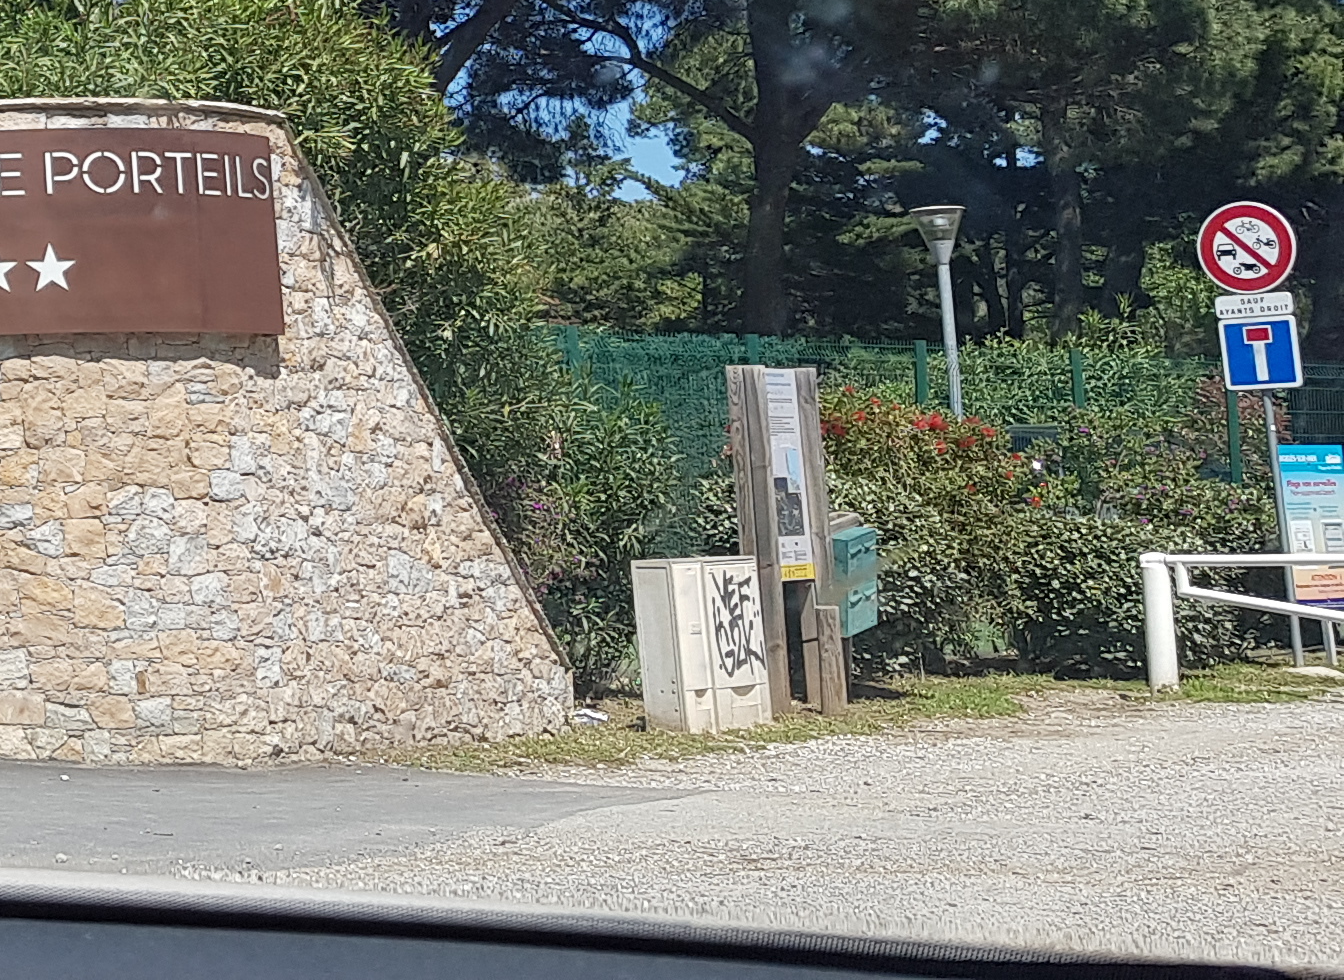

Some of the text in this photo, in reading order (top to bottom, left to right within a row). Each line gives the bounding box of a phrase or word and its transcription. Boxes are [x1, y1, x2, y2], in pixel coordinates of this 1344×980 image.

[44, 151, 270, 200] PORTEILS
[1240, 297, 1265, 305] SAUF
[1219, 304, 1289, 315] AYANTS DROIT
